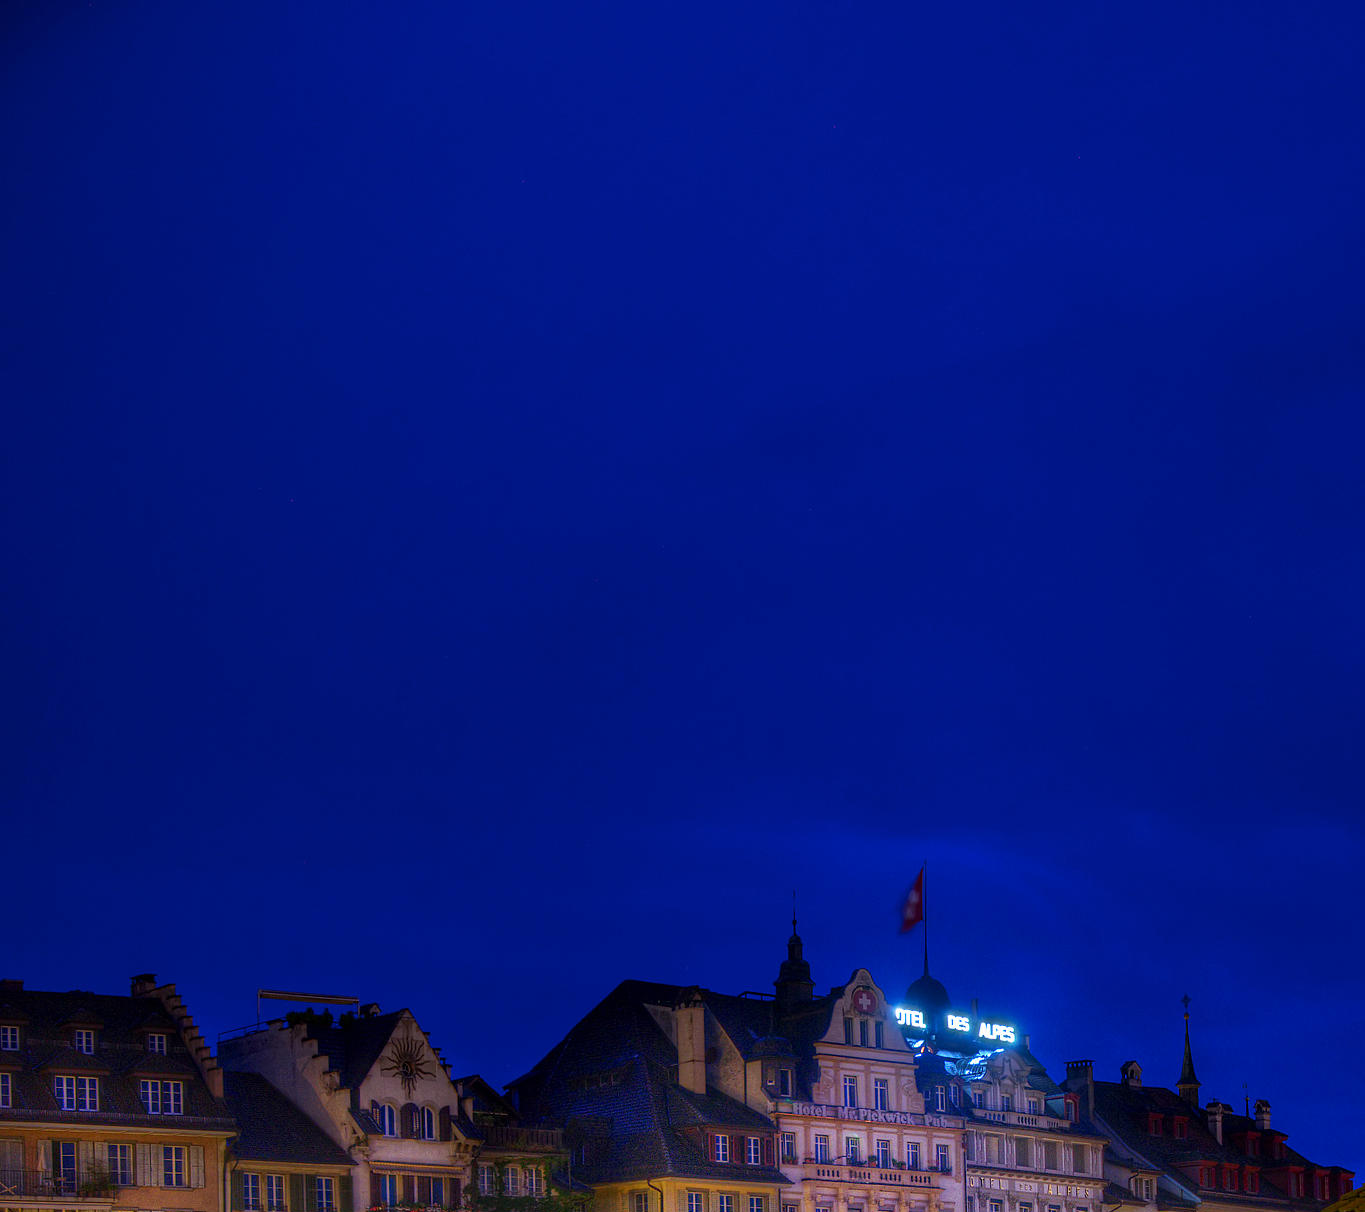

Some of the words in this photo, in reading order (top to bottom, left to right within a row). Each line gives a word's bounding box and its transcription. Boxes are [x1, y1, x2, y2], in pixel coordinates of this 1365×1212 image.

[947, 1015, 969, 1032] DES
[979, 1022, 1015, 1043] ALPES
[792, 1103, 827, 1117] Hotel
[859, 1109, 914, 1125] Pickwick
[924, 1114, 948, 1128] Pub
